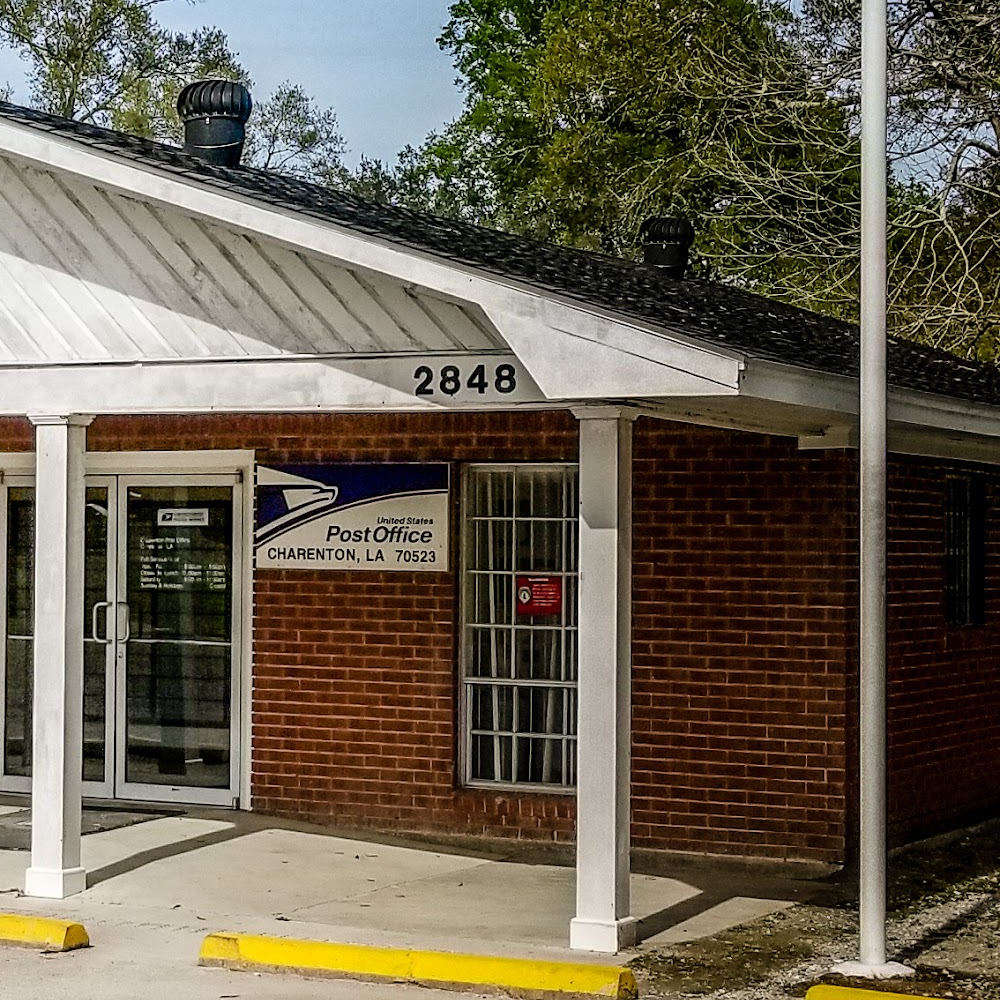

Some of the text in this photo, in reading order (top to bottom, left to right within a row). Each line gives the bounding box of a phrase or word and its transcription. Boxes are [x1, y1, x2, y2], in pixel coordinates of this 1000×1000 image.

[414, 364, 516, 395] 2848
[377, 516, 434, 525] United States
[267, 548, 436, 563] CHARENTON, LA 70523
